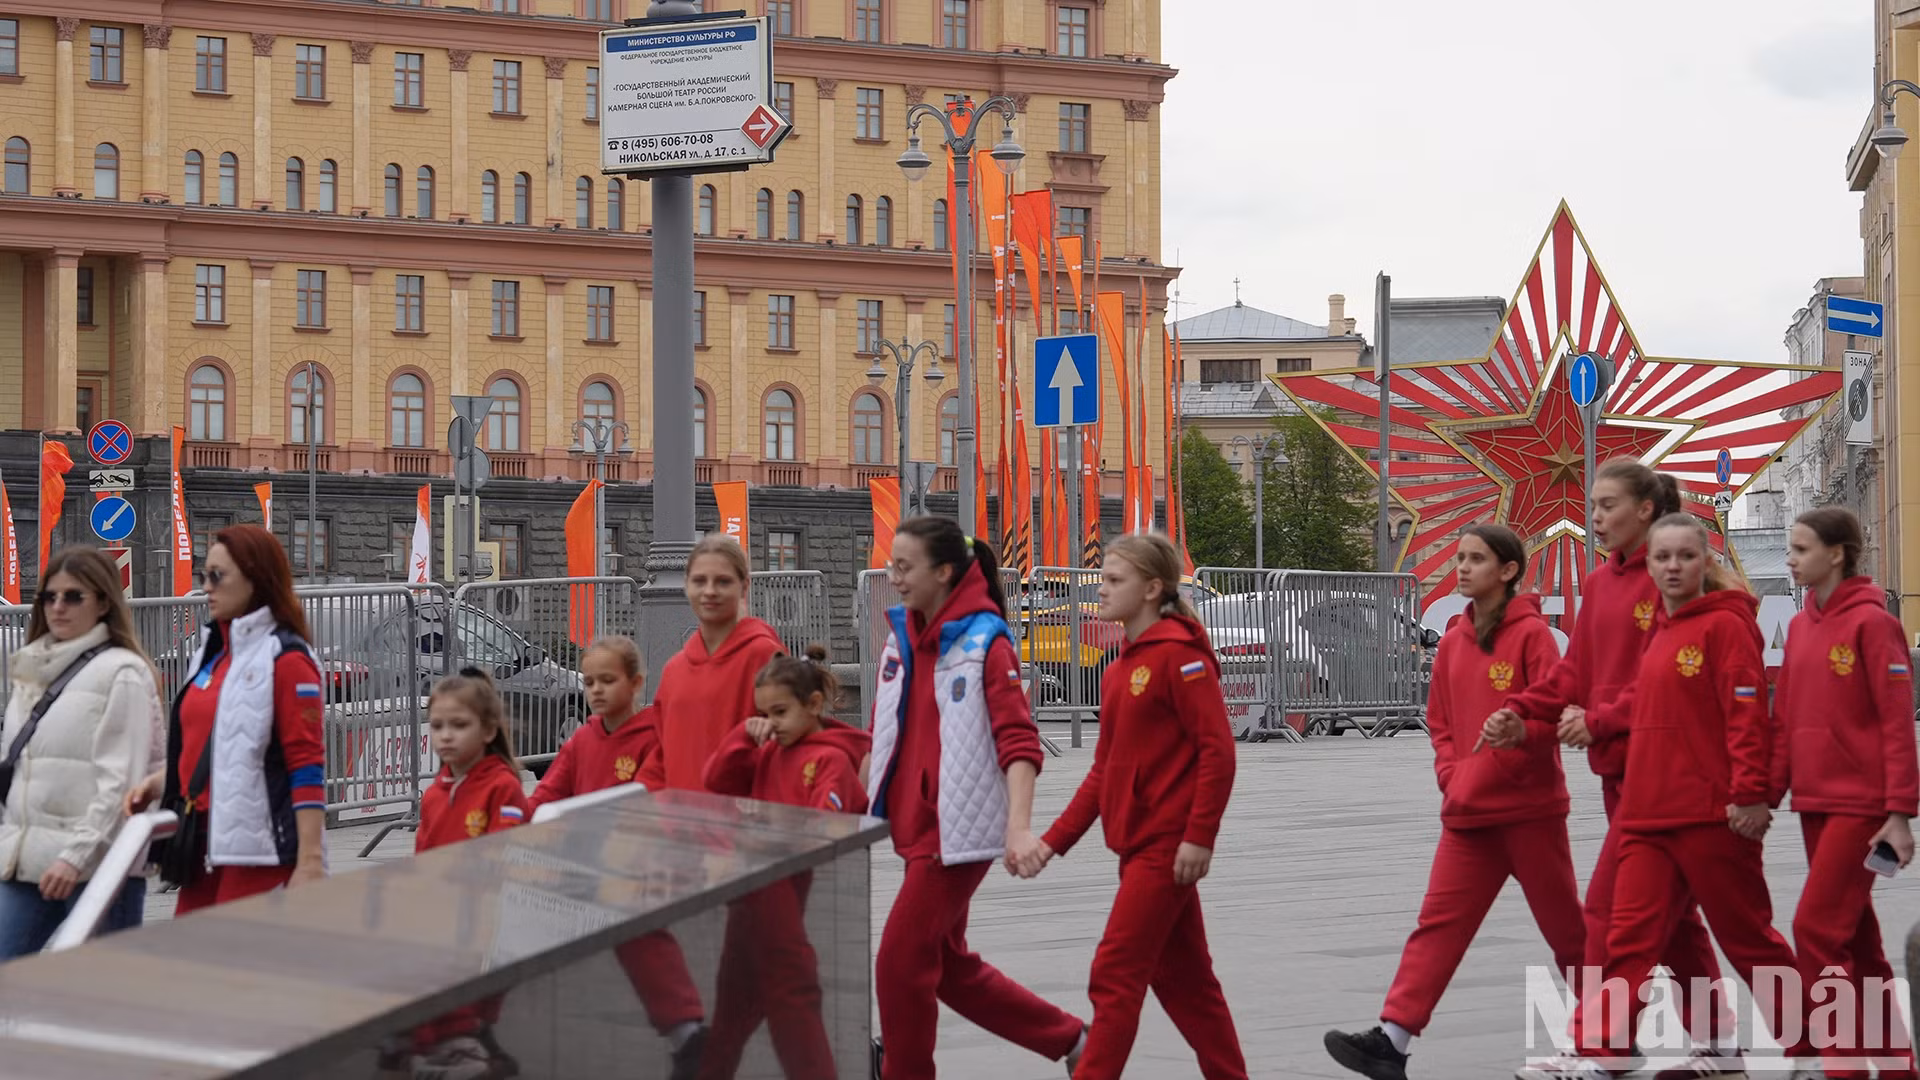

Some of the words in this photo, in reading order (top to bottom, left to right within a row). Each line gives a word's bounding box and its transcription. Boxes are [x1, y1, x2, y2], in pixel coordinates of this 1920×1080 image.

[627, 35, 686, 47] МИНИСТЕРСТВО
[686, 31, 724, 42] КУЛЬТУРЫ
[725, 30, 736, 38] РФ
[620, 51, 658, 60] ФЕДЕРАЛЬНОЕ
[659, 47, 708, 57] ГОСУДАРСТВЕННОЕ
[709, 44, 743, 53] БЮДЖЕТНОЕ
[650, 56, 685, 65] УЧРЕЖДЕНИЕ
[686, 54, 713, 62] КУЛЬТУРЫ
[687, 72, 751, 86] АКАДЕМИЧЕСКИЙ
[636, 88, 673, 100] БОЛЬШОЙ
[674, 88, 696, 97] ТЕАТР
[697, 86, 727, 95] РОССИИ
[607, 102, 648, 112] КАМЕРНАЯ
[648, 100, 673, 110] СЦЕНА
[621, 139, 629, 150] 8
[631, 138, 658, 151] (495)
[660, 134, 714, 147] 606-70-08
[619, 150, 687, 164] НИКОЛЬСКАЯ
[740, 147, 747, 155] 1
[1850, 356, 1867, 367] ЗОНА
